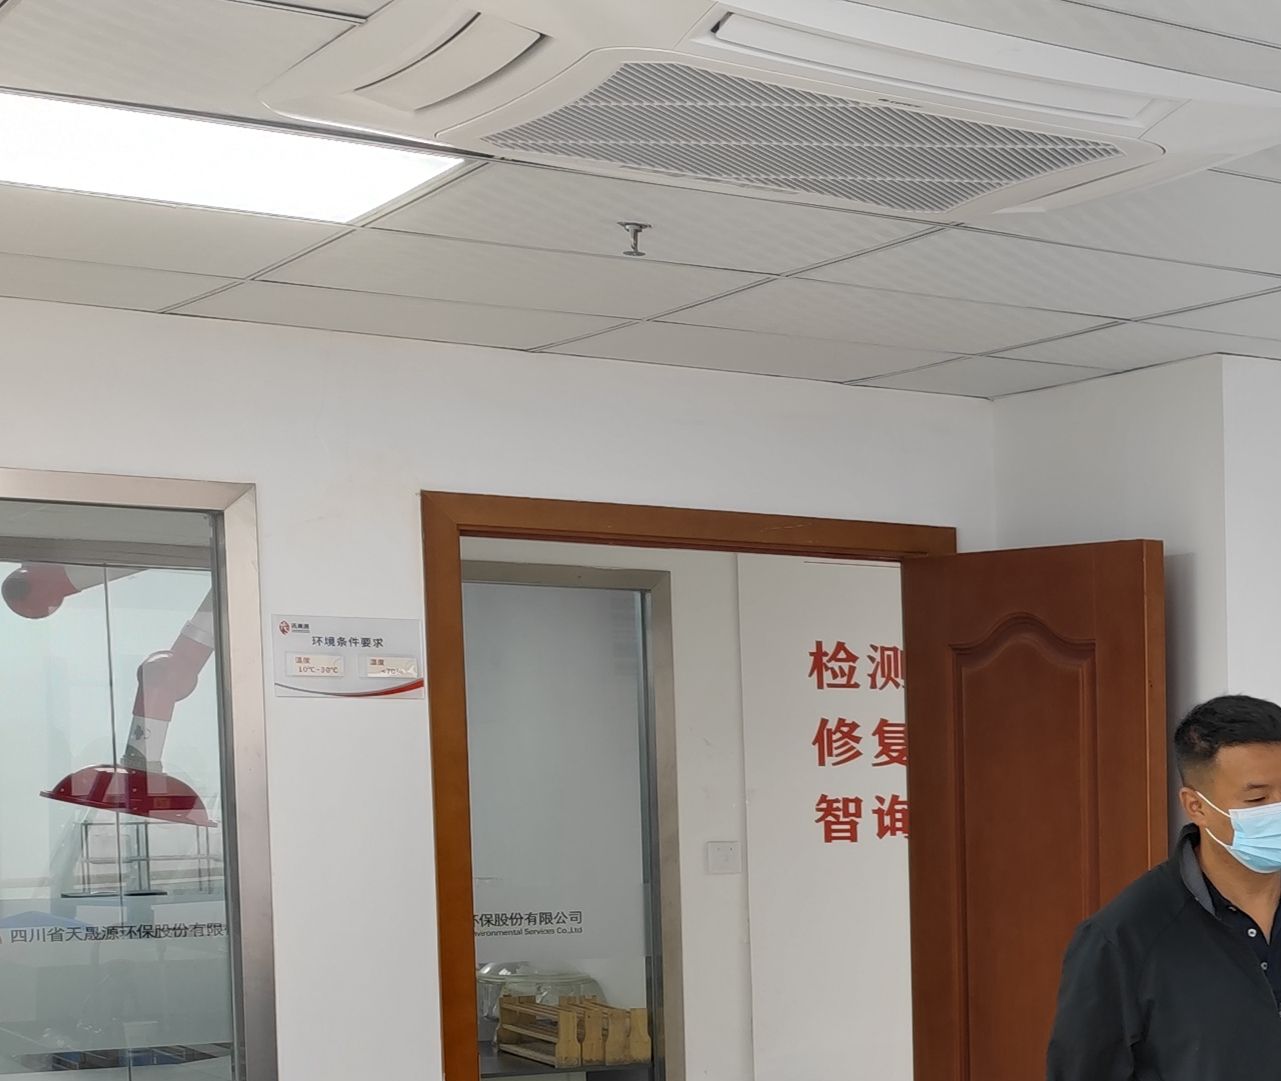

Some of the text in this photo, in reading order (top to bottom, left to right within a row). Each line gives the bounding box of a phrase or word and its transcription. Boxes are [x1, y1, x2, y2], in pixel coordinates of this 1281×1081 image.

[312, 635, 384, 648] 环境条件要求
[808, 640, 906, 690] 检测
[811, 718, 910, 767] 修复
[814, 794, 910, 843] 智询
[10, 922, 231, 944] 四川省天晟源环保股份有限
